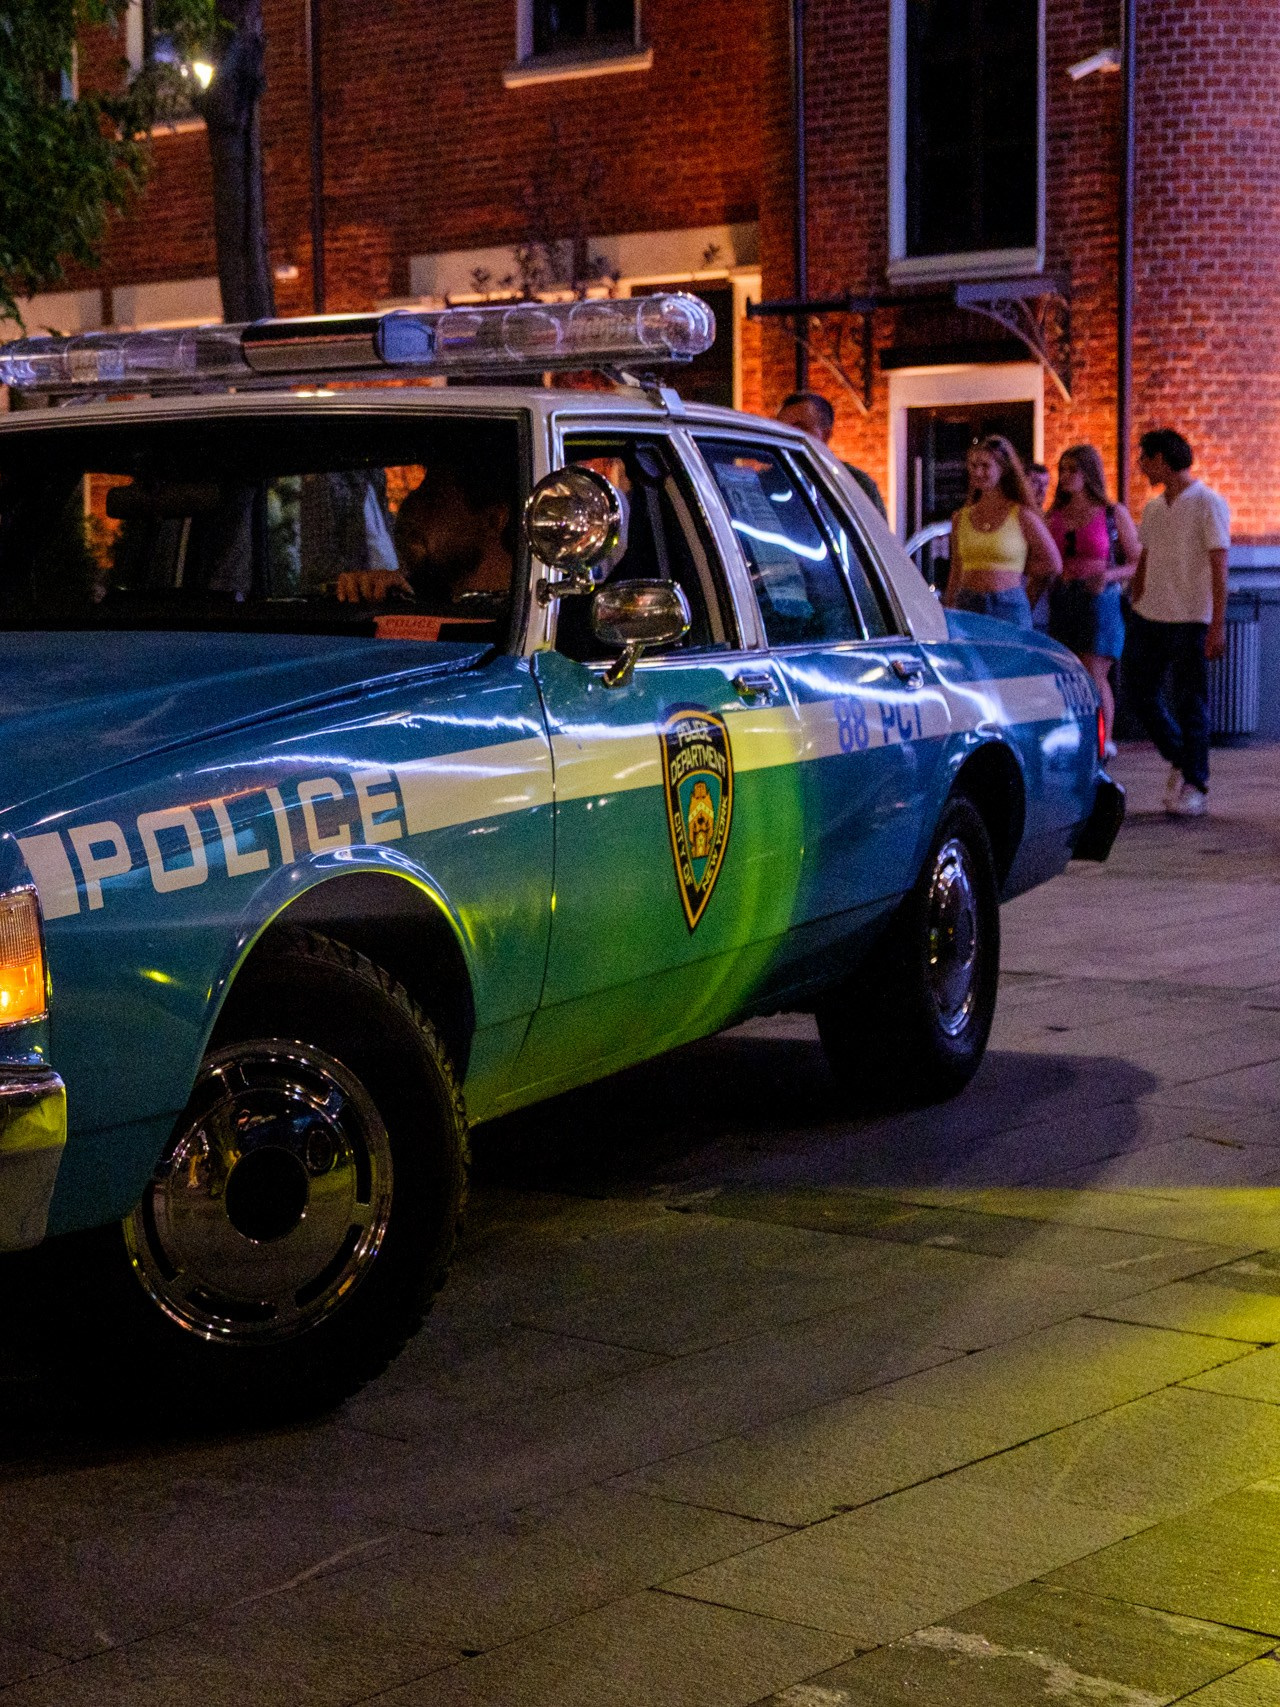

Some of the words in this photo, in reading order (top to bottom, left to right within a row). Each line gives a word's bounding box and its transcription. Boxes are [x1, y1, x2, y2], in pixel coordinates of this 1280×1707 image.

[677, 720, 713, 748] POLICE
[832, 696, 870, 754] 88
[879, 700, 923, 744] PCT
[670, 745, 727, 786] DEPARTMENT
[68, 769, 404, 911] POLICE
[673, 811, 687, 858] CITY
[682, 863, 693, 886] OF
[701, 851, 719, 892] NEW
[715, 795, 729, 847] YORK
